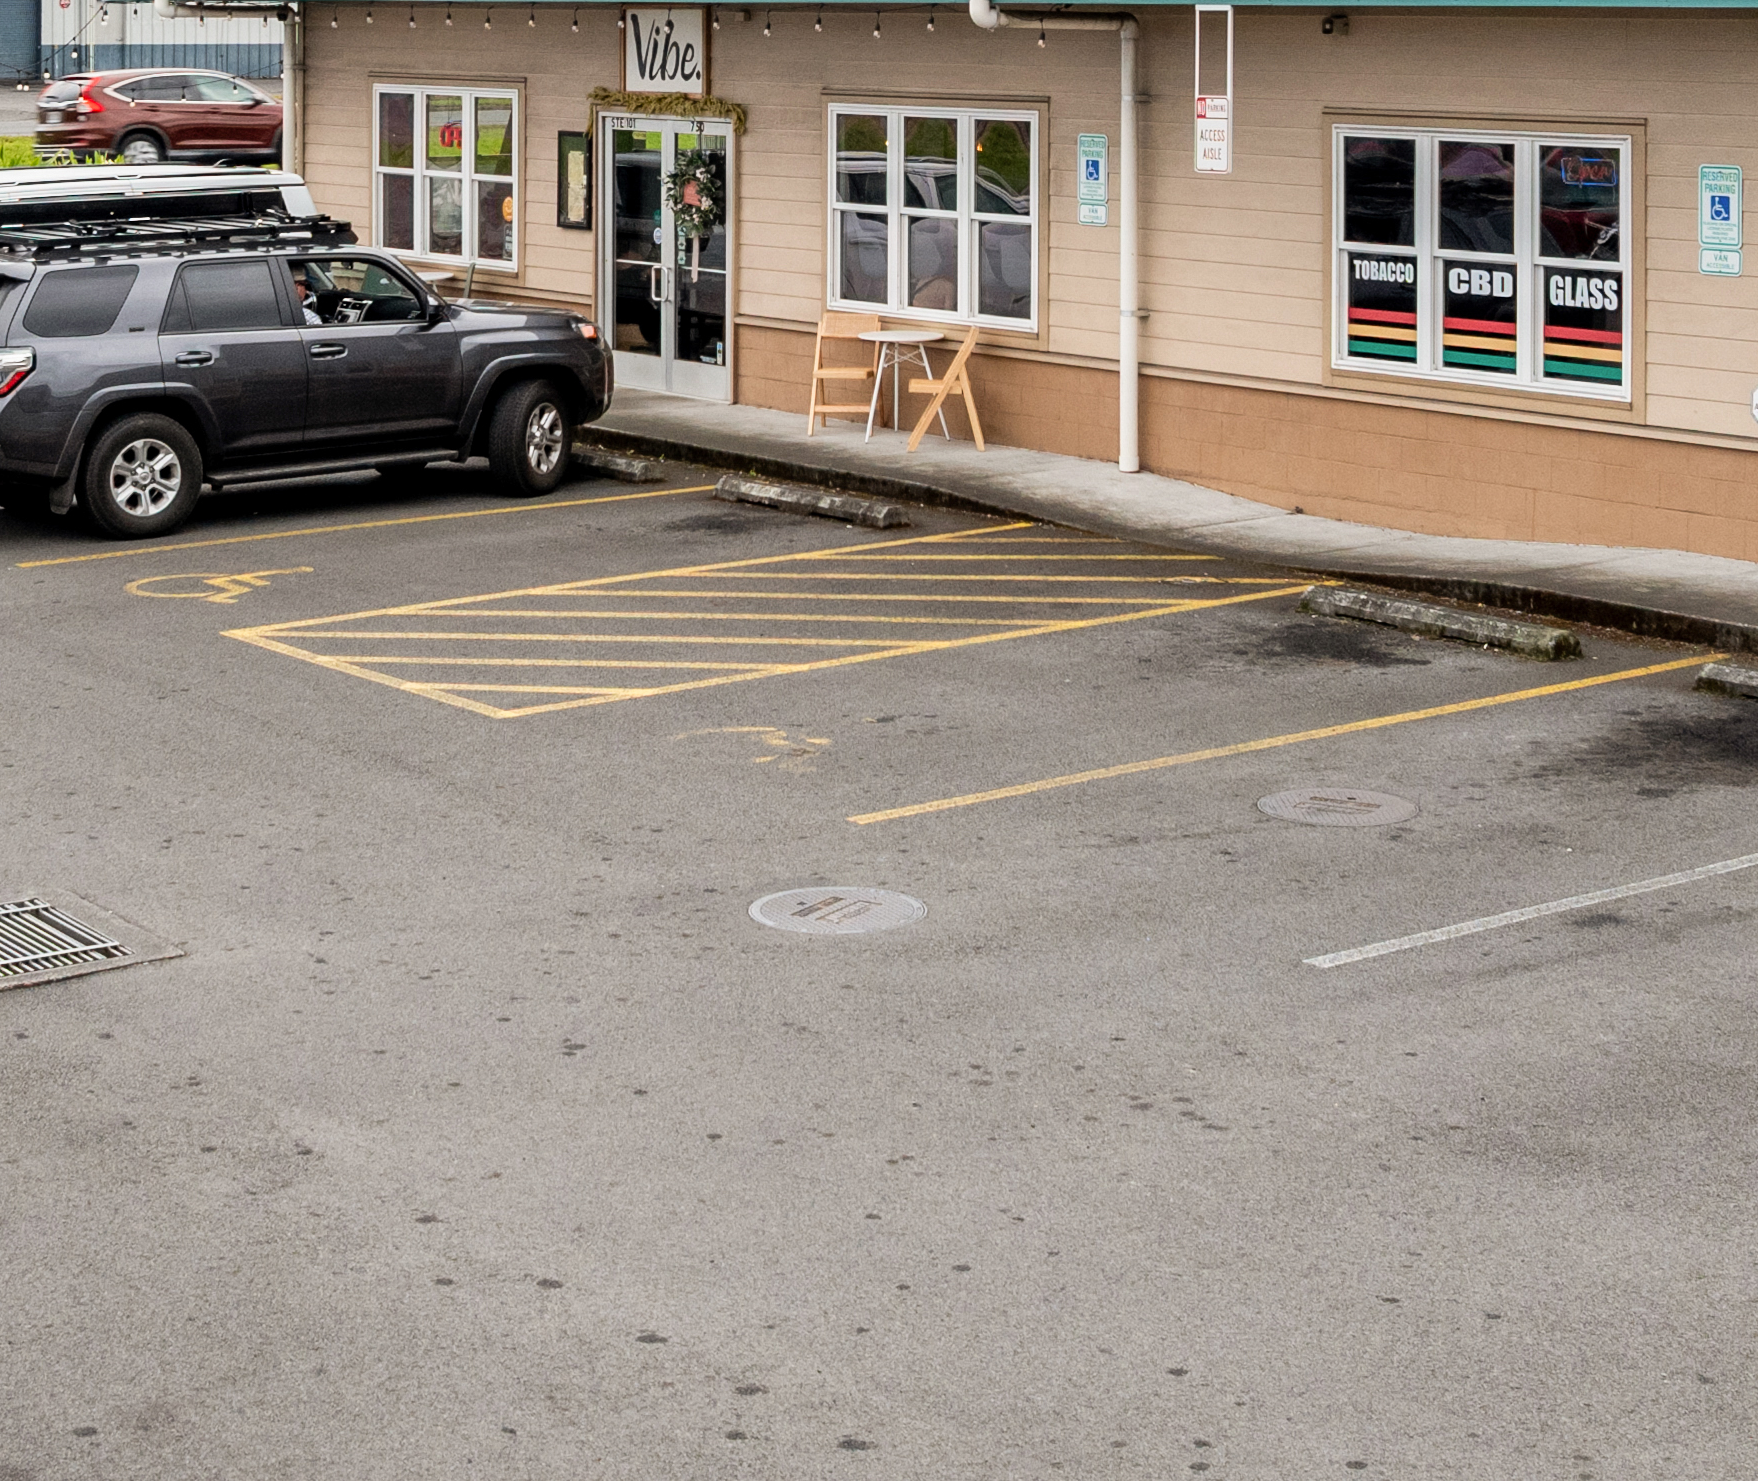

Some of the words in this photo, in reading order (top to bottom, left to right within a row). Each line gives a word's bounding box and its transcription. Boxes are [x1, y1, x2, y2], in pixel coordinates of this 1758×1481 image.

[630, 13, 701, 82] Vibe.
[611, 118, 624, 128] STE
[626, 118, 636, 129] 101
[690, 120, 705, 133] 750
[1199, 129, 1225, 142] ACCESS
[1080, 139, 1105, 149] RESERVED
[1082, 149, 1103, 159] PARKING
[1203, 147, 1222, 161] AISLE
[1703, 170, 1738, 183] RESERVED
[1704, 183, 1736, 195] PARKING
[1713, 253, 1729, 263] VAN
[1353, 259, 1414, 284] TOBACCO
[1448, 267, 1514, 298] CBD
[1549, 274, 1619, 311] GLASS
